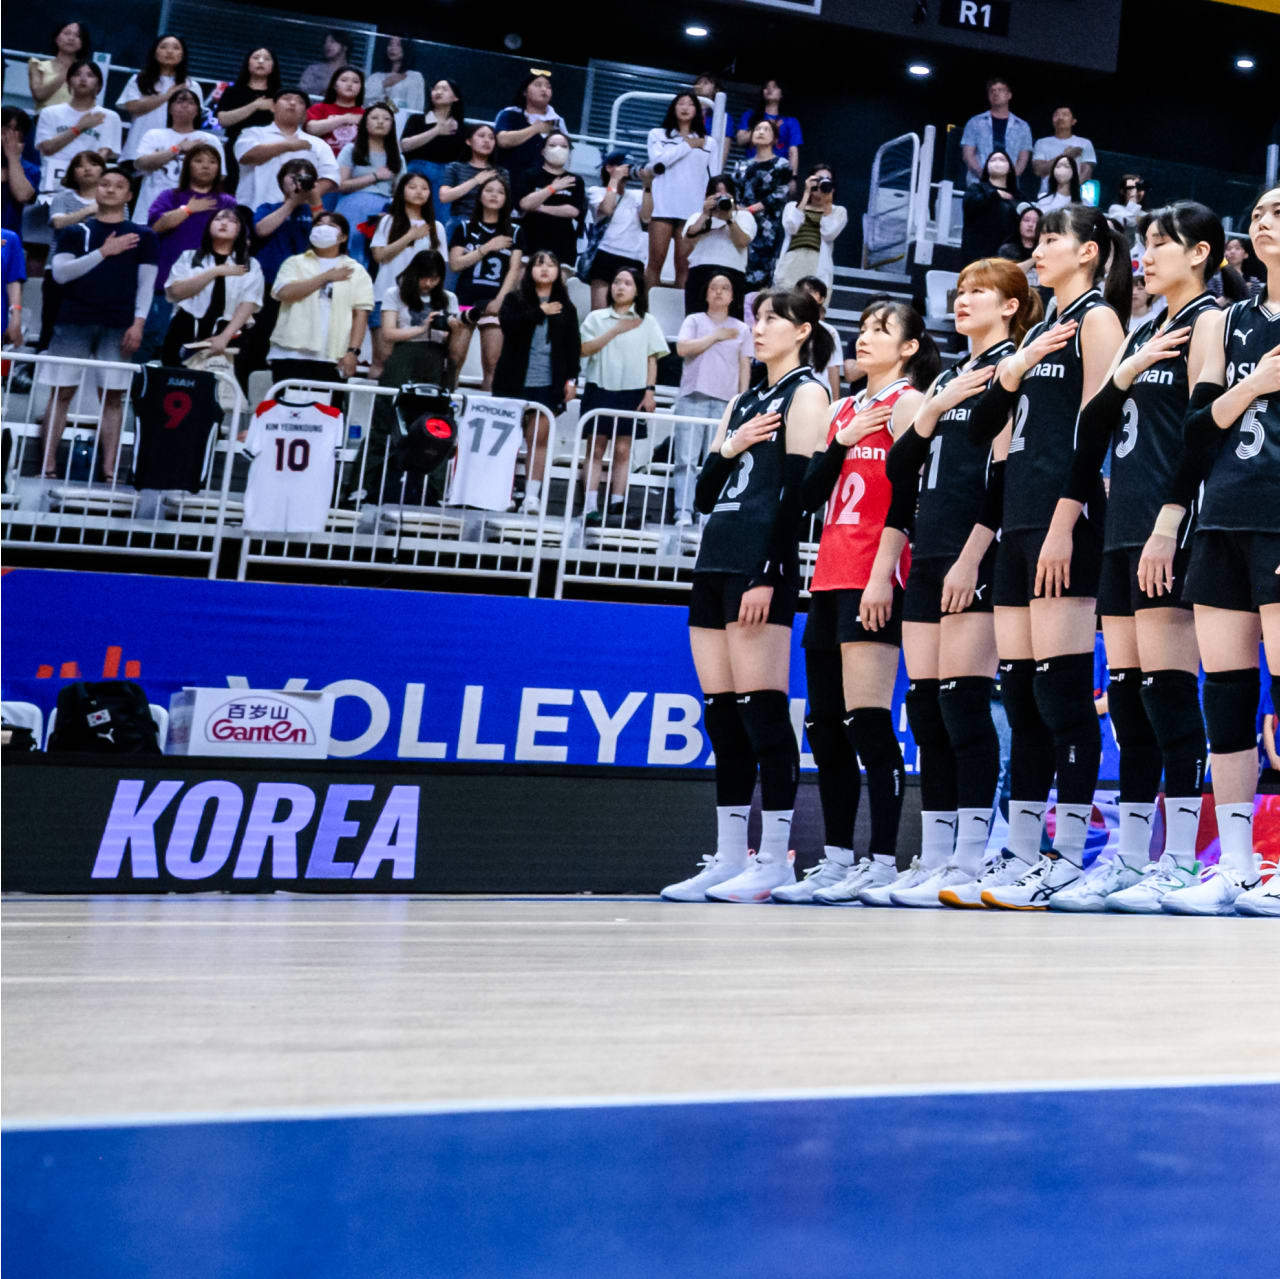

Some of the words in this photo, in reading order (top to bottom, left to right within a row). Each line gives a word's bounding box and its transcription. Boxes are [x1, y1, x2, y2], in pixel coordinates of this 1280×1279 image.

[958, 0, 993, 28] R1
[163, 391, 192, 429] 9
[467, 417, 515, 457] 17
[1234, 399, 1269, 460] 5
[275, 438, 310, 471] 10
[227, 703, 289, 721] 百岁山
[91, 780, 421, 880] KOREA
